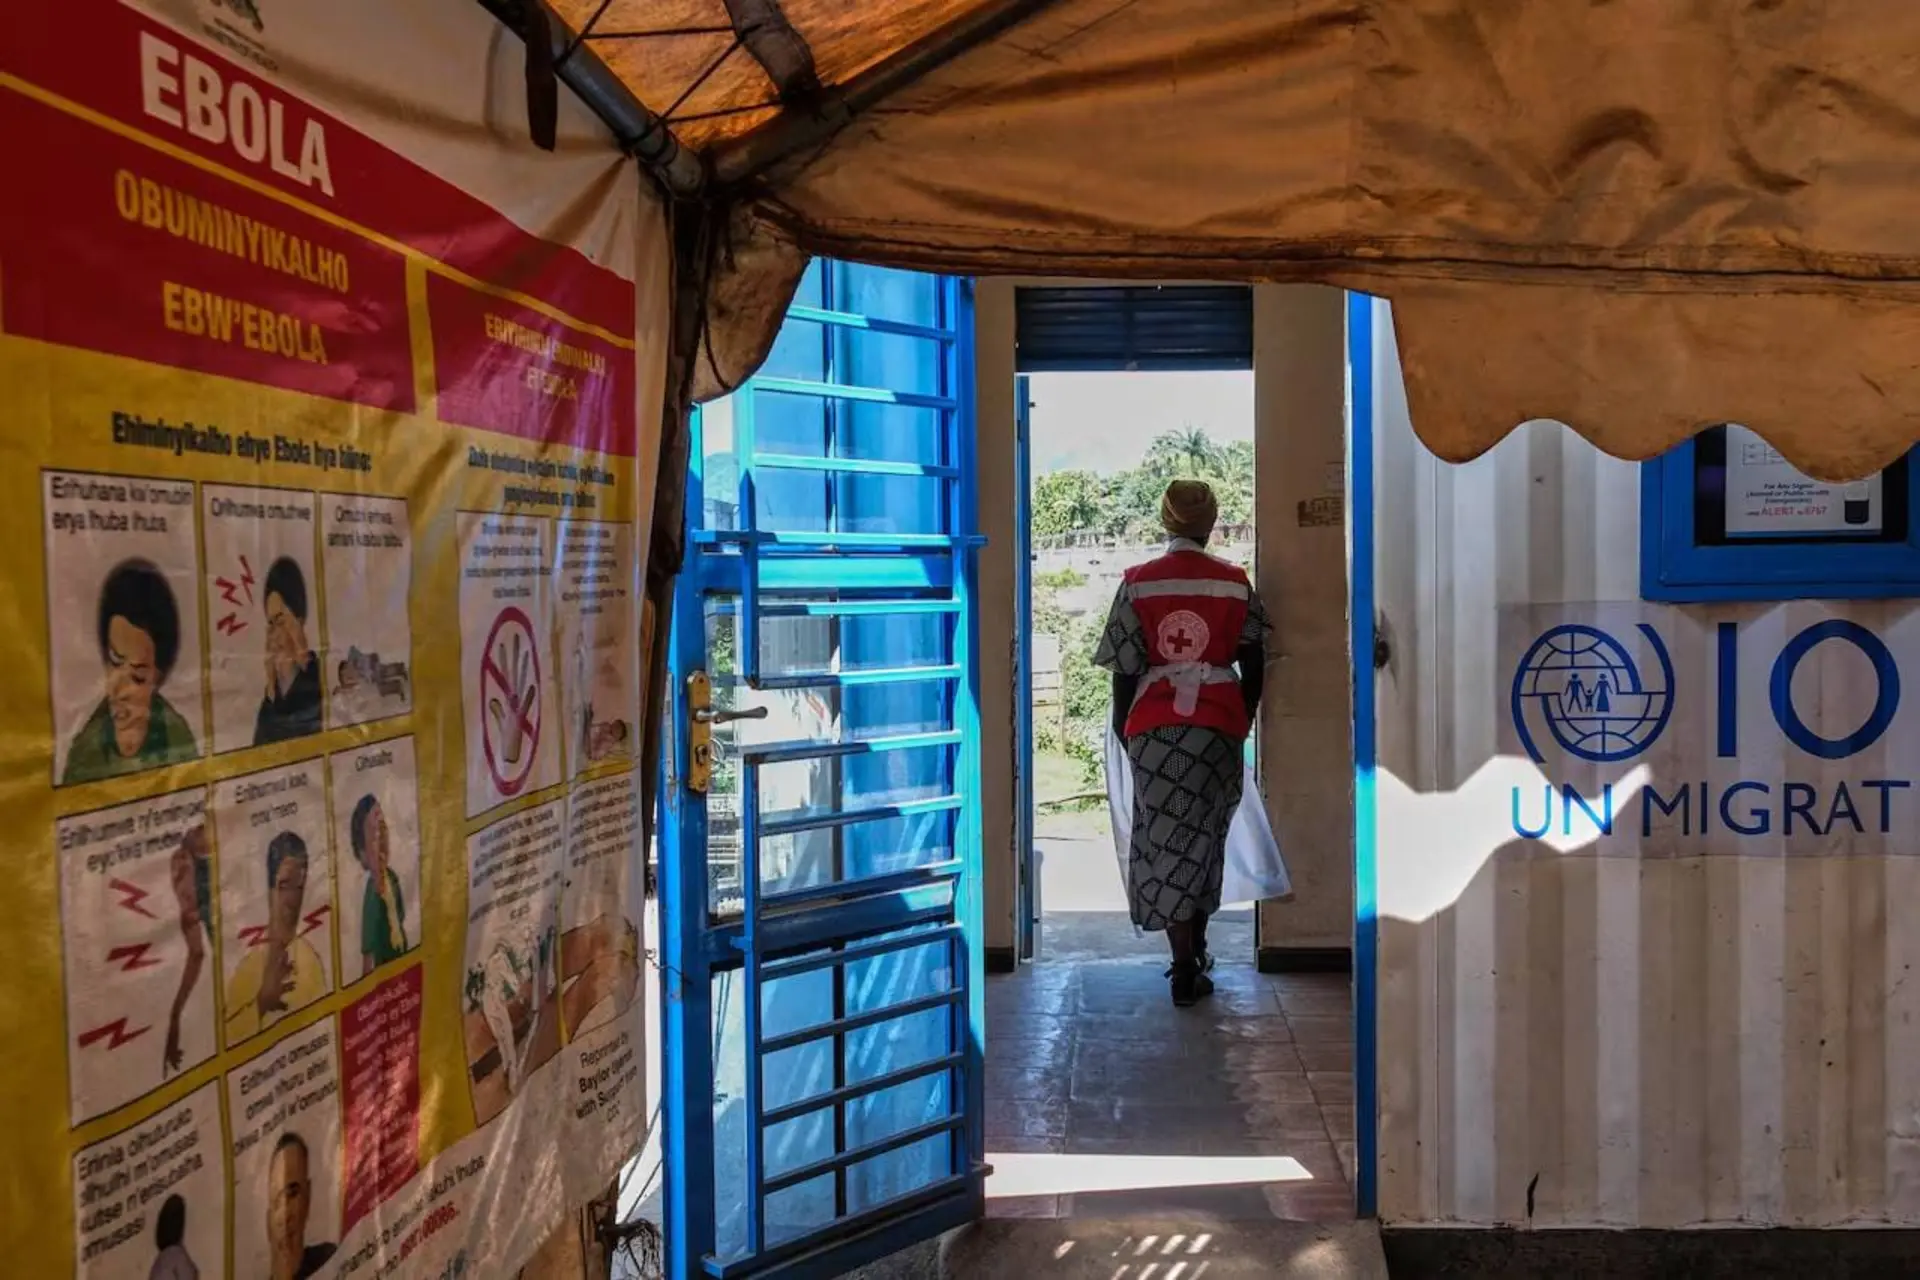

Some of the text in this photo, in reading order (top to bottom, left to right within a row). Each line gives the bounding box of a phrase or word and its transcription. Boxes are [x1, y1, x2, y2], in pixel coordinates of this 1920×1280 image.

[140, 30, 335, 197] EBOLA
[115, 170, 350, 293] OBUMINYIKALHO
[163, 281, 328, 364] EBW'EBOLA
[274, 434, 310, 465] Ebola
[1761, 505, 1794, 516] ALERT
[1511, 779, 1910, 840] UN MIGRAT
[578, 1067, 611, 1094] Baylor
